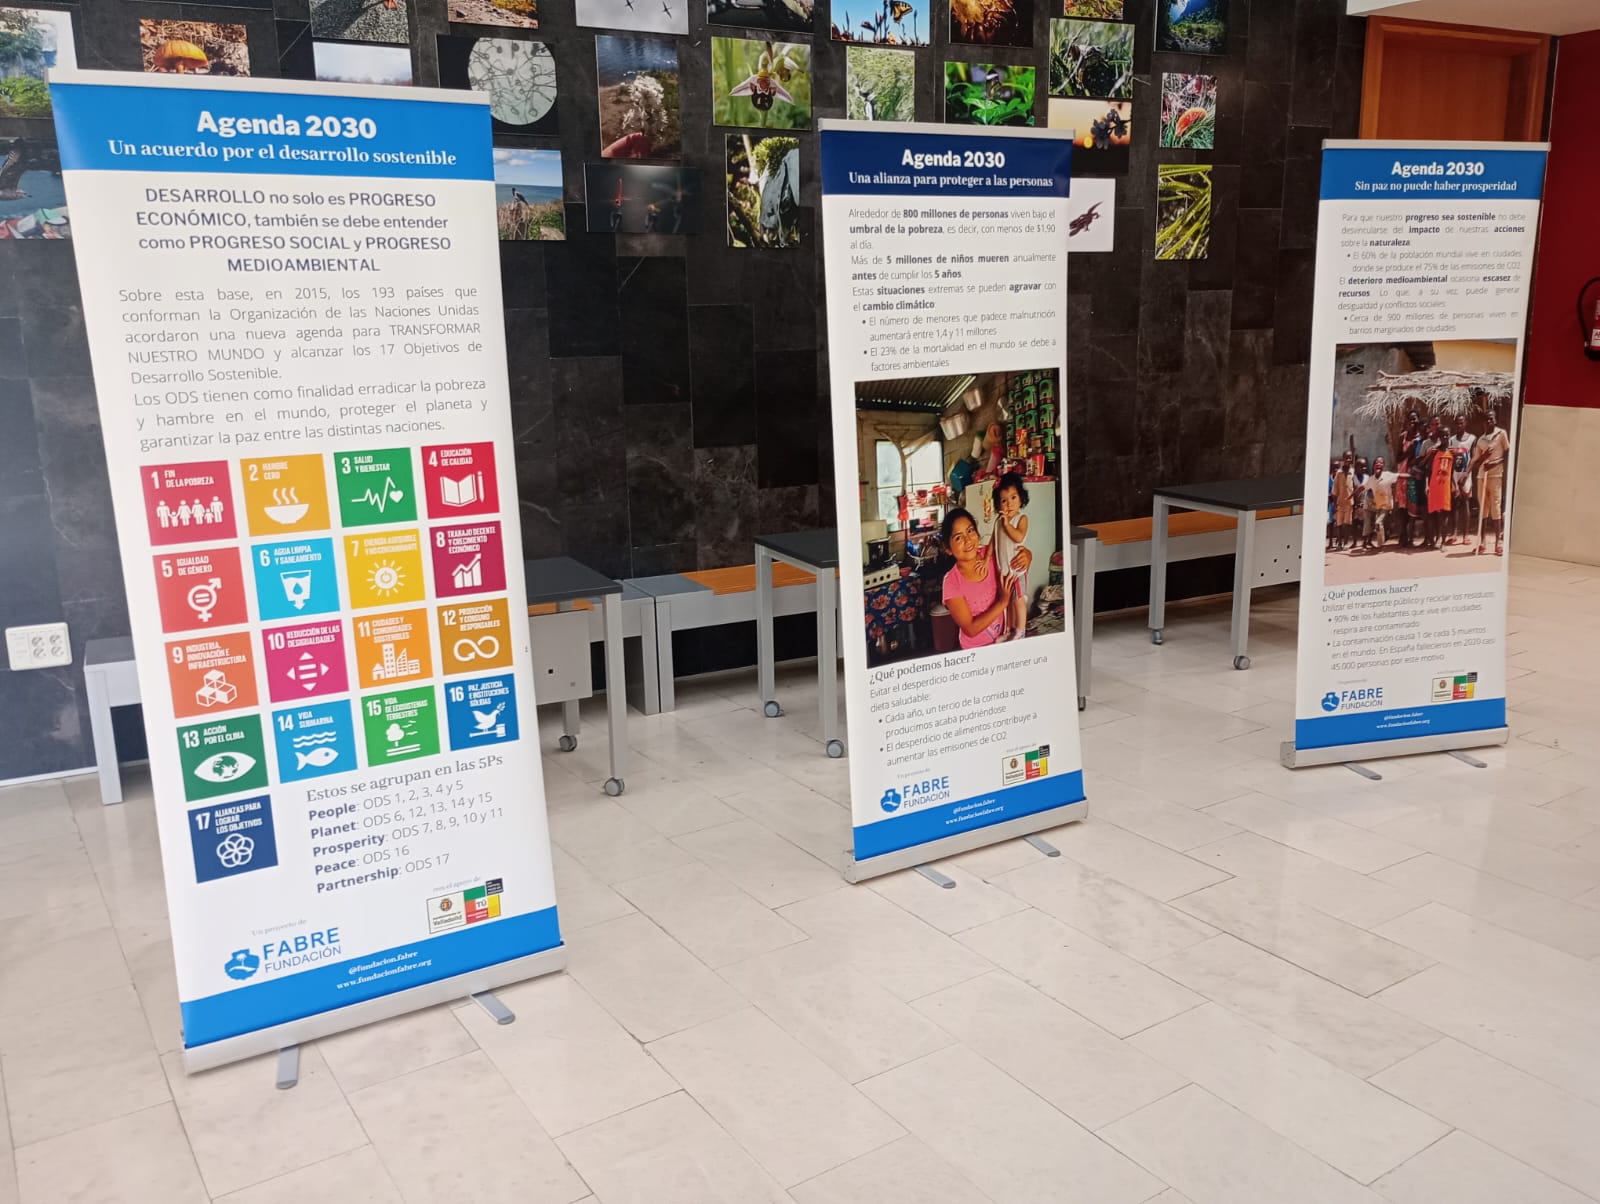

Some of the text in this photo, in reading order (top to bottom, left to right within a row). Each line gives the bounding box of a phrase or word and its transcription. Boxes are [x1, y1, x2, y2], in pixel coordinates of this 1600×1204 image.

[196, 111, 376, 138] Agenda 2030
[108, 139, 456, 164] Un acuerdo por el desarrollo sostenible
[901, 148, 1005, 169] Agenda 2030
[1390, 161, 1484, 177] Agenda 2030
[848, 171, 1052, 188] Una alianza para proteger a las personas
[1354, 180, 1369, 190] Sin
[1371, 182, 1388, 192] paz
[1403, 180, 1432, 192] puede
[1433, 180, 1460, 190] haber
[1461, 180, 1516, 192] prosperidad
[145, 187, 435, 206] DESARROLLO no solo es PROGRESO
[135, 208, 448, 228] ECONÓMICO, también se debe entender
[848, 208, 1055, 220] Alrededor de 800 millones de personas viven bajo el
[1405, 213, 1439, 222] progreso
[1441, 213, 1455, 221] sea
[1456, 212, 1496, 221] sostenible
[1408, 225, 1440, 235] impacto
[1493, 224, 1524, 232] acciones
[138, 235, 450, 251] como PROGRESO SOCIAL y PROGRESO
[227, 258, 380, 271] MEDIOAMBIENTAL
[851, 272, 876, 280] antes
[878, 271, 888, 279] de
[890, 269, 918, 280] cumplir
[920, 270, 932, 278] los
[934, 269, 939, 278] 5
[118, 285, 477, 301] Sobre esta base, en 2015, los 193 países que
[852, 299, 934, 311] el cambio climático
[134, 379, 485, 406] Los ODS tienen como finalidad erradicar la pobreza
[342, 458, 350, 474] 3
[354, 456, 373, 464] SALUD
[429, 452, 438, 467] 4
[151, 471, 159, 489] 1
[165, 470, 175, 478] FIN
[249, 464, 258, 481] 2
[166, 477, 214, 488] DE LA POBREZA
[436, 532, 445, 547] 8
[352, 541, 359, 556] 7
[260, 550, 270, 566] 6
[162, 561, 172, 577] 5
[1322, 583, 1418, 601] ¿Qué podemos hacer?
[443, 610, 456, 626] 12
[358, 622, 370, 637] 11
[268, 633, 285, 650] 10
[172, 647, 183, 663] 9
[869, 652, 975, 684] ¿Qué podemos hacer?
[450, 687, 464, 702] 16
[1341, 687, 1382, 701] FABRE
[367, 700, 381, 716] 15
[1340, 699, 1382, 710] FUNDACIÓN
[203, 725, 227, 735] ACCIÓN
[278, 715, 294, 731] 14
[183, 731, 200, 748] 13
[204, 736, 218, 745] POR
[226, 732, 245, 741] CLIMA
[306, 754, 502, 801] Estos se agrupan en las 5Ps
[903, 775, 949, 798] FABRE
[903, 789, 949, 808] FUNDACIÓN
[215, 802, 261, 817] ALIANZAS PARA
[195, 812, 210, 830] 17
[216, 815, 240, 826] LOGRAR
[216, 826, 228, 834] LOS
[314, 844, 409, 875] Peace: ODS 16
[316, 852, 449, 893] Partnership: ODS 17
[262, 927, 339, 960] FABRE
[264, 944, 341, 972] FUNDACIÓN
